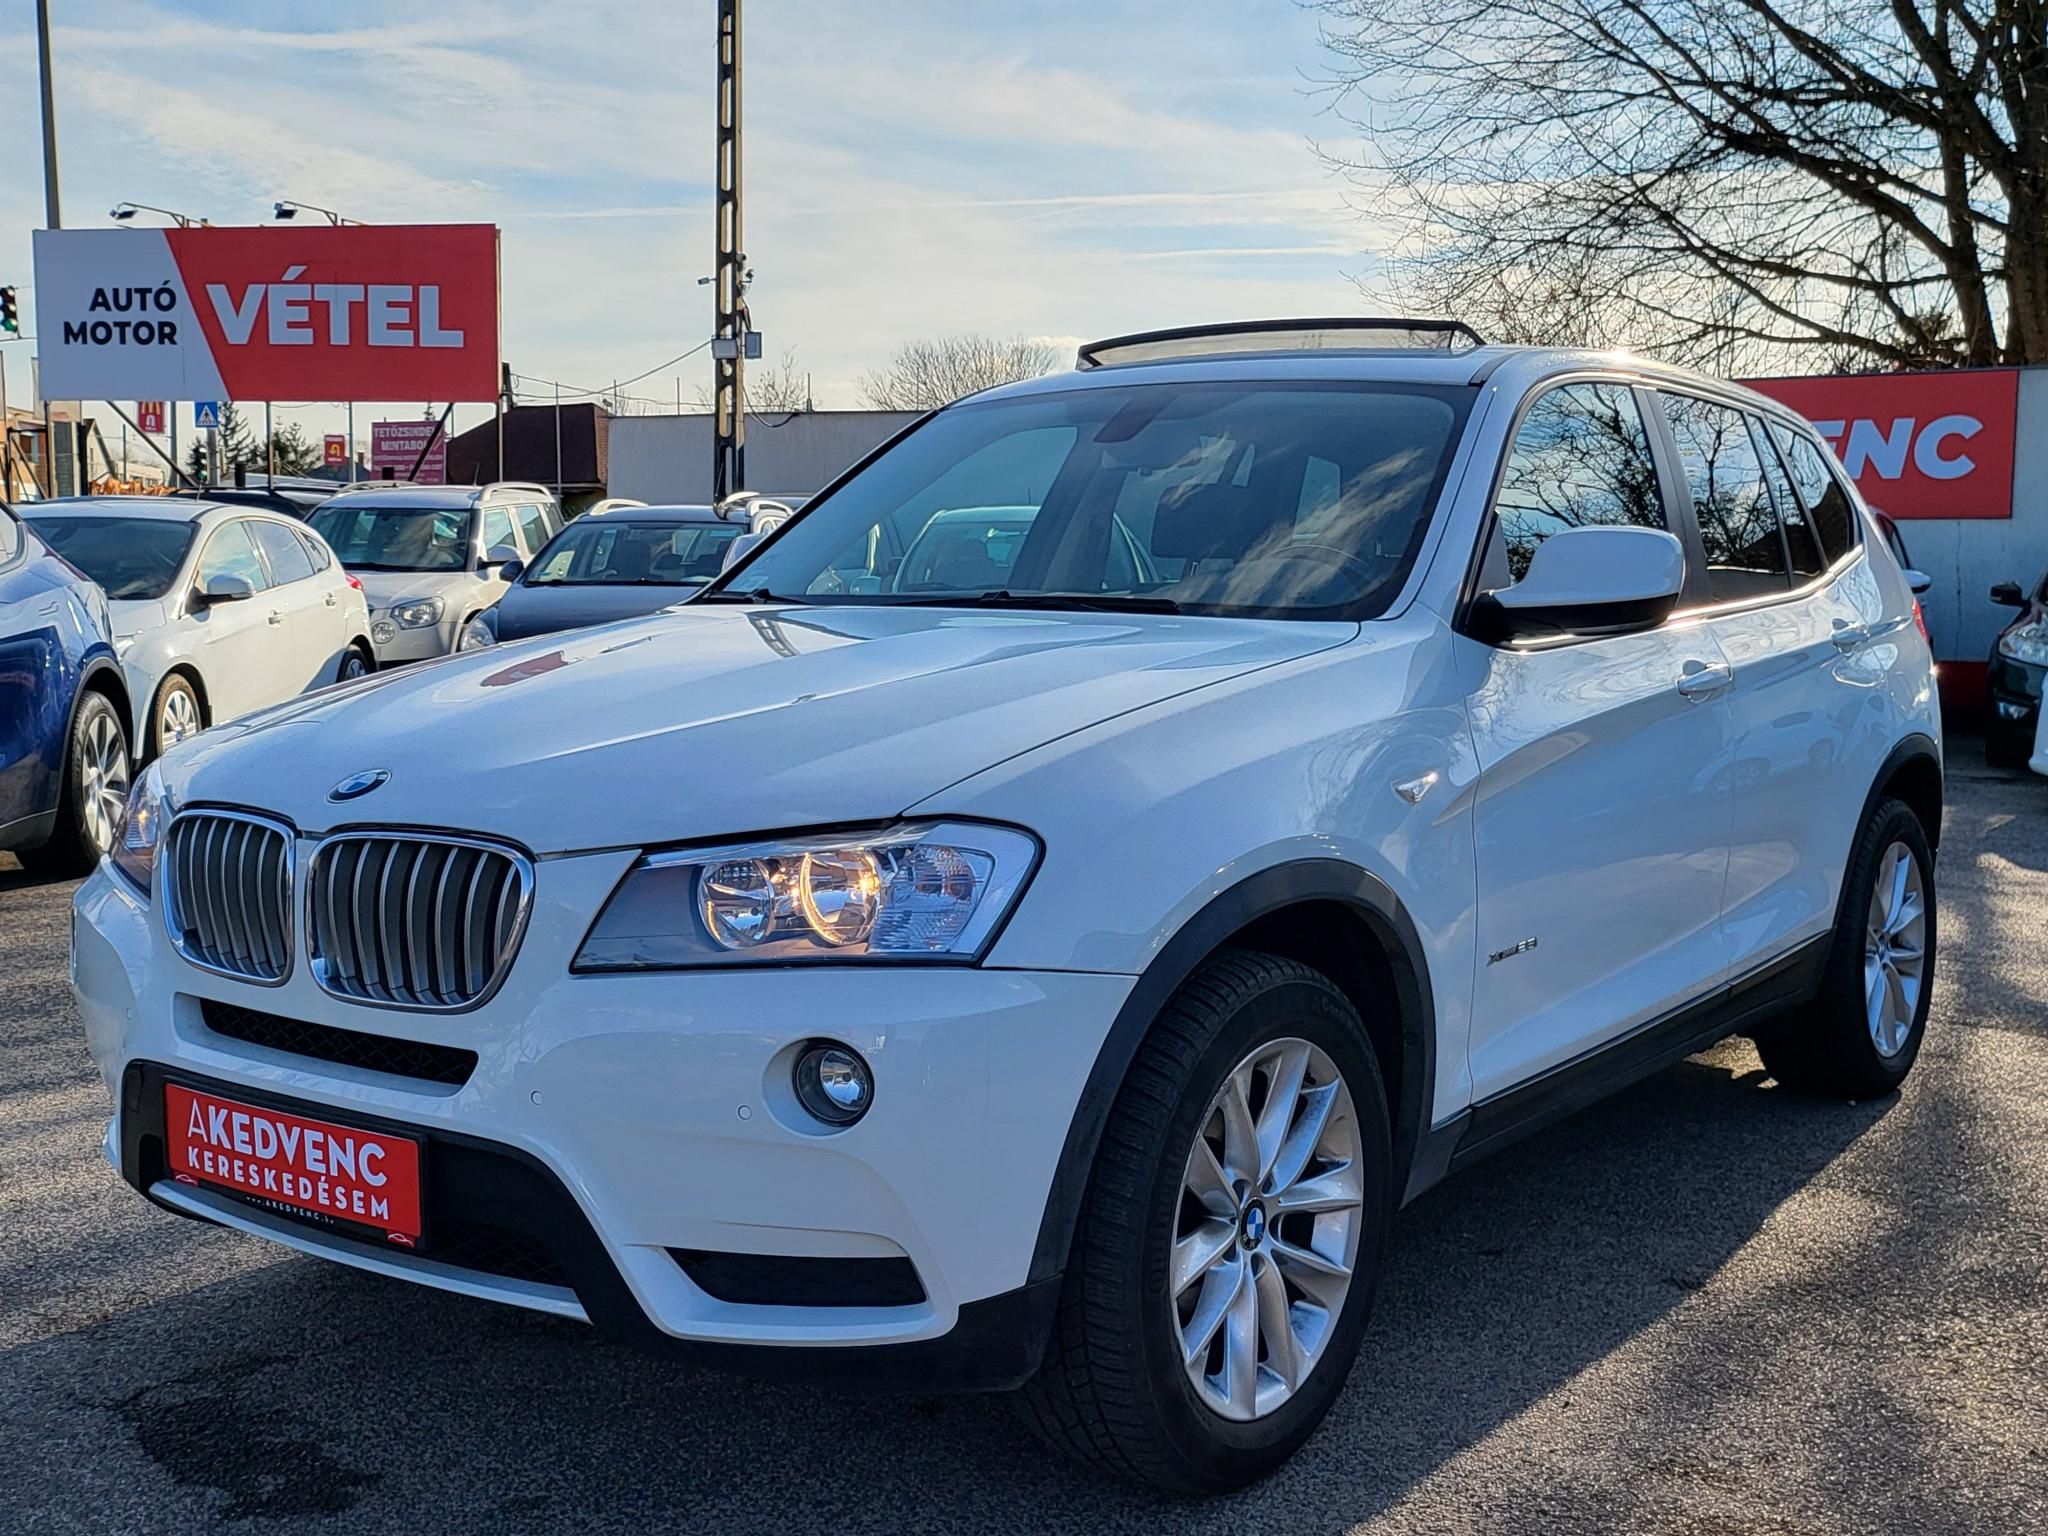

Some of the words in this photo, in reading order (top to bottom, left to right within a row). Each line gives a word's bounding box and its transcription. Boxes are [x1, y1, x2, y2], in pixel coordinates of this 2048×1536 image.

[89, 280, 177, 312] AUTÓ
[205, 265, 464, 348] VÉTEL
[63, 321, 178, 345] MOTOR
[187, 1145, 389, 1221] KERESKEDÉSEM
